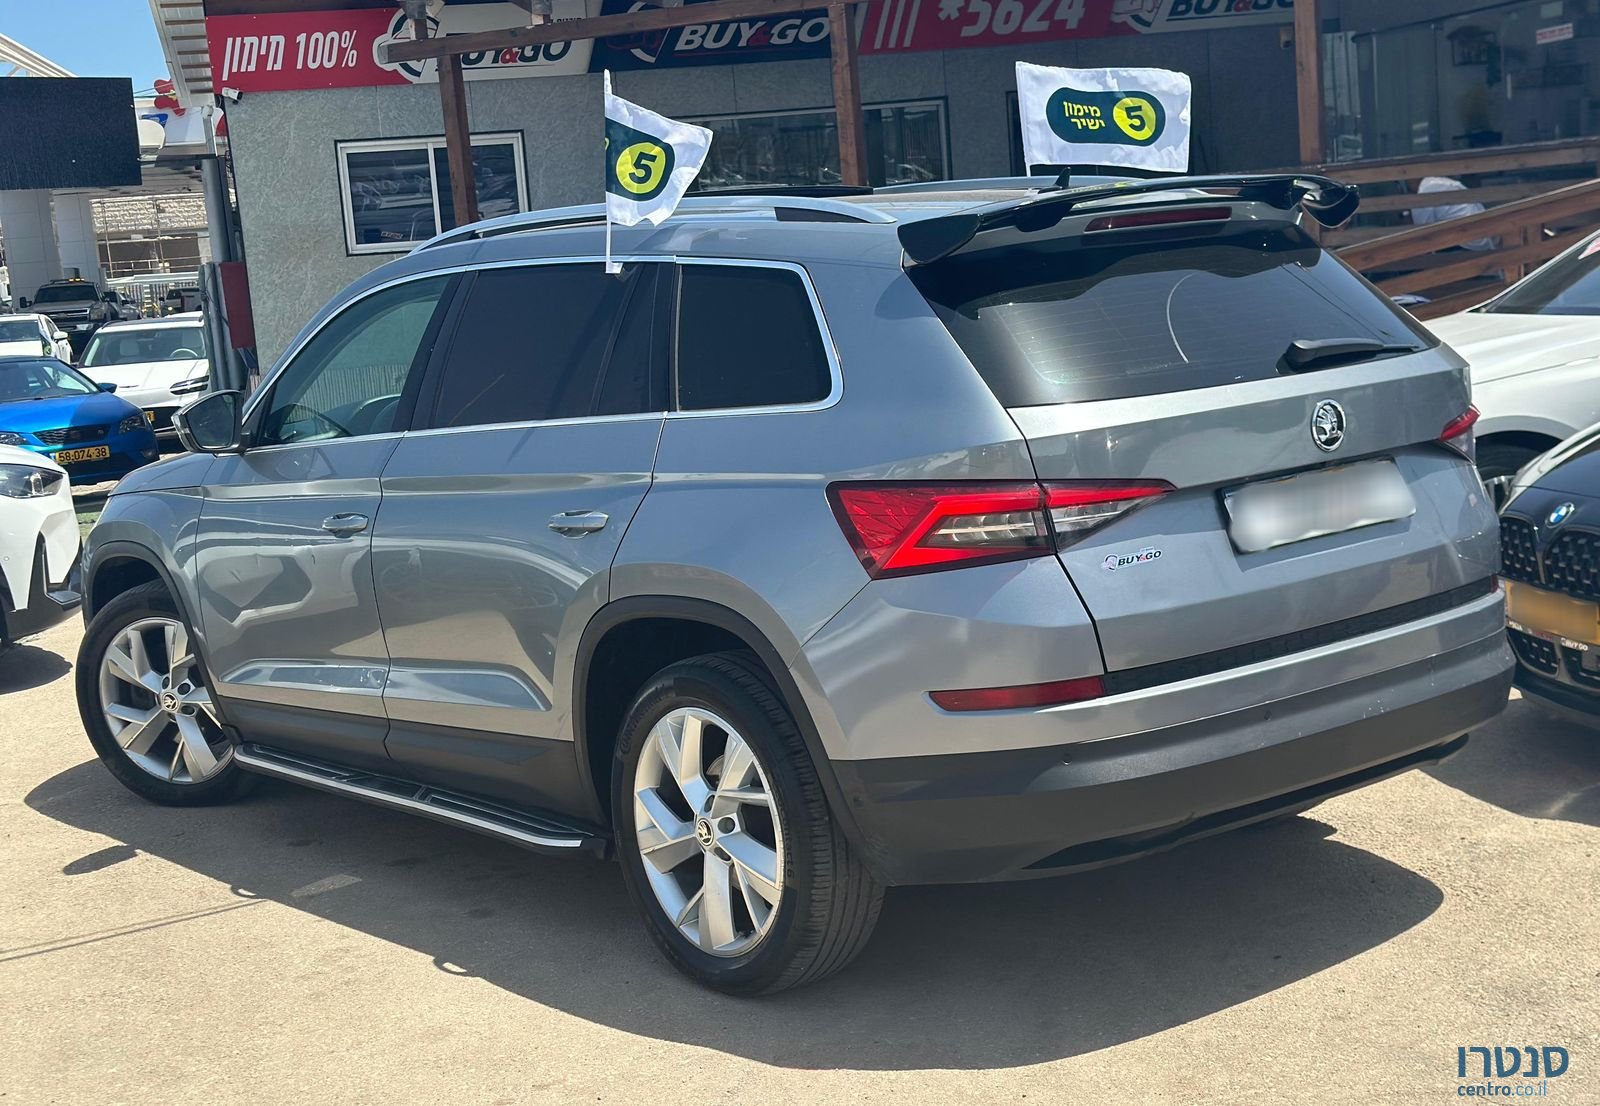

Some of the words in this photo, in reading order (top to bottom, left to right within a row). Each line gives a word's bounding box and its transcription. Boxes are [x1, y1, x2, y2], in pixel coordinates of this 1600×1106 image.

[221, 35, 286, 81] מימון
[296, 29, 358, 70] 100%
[1063, 101, 1101, 118] מימון
[1071, 118, 1106, 130] ישיר
[1124, 104, 1146, 132] 5
[628, 151, 658, 185] 5
